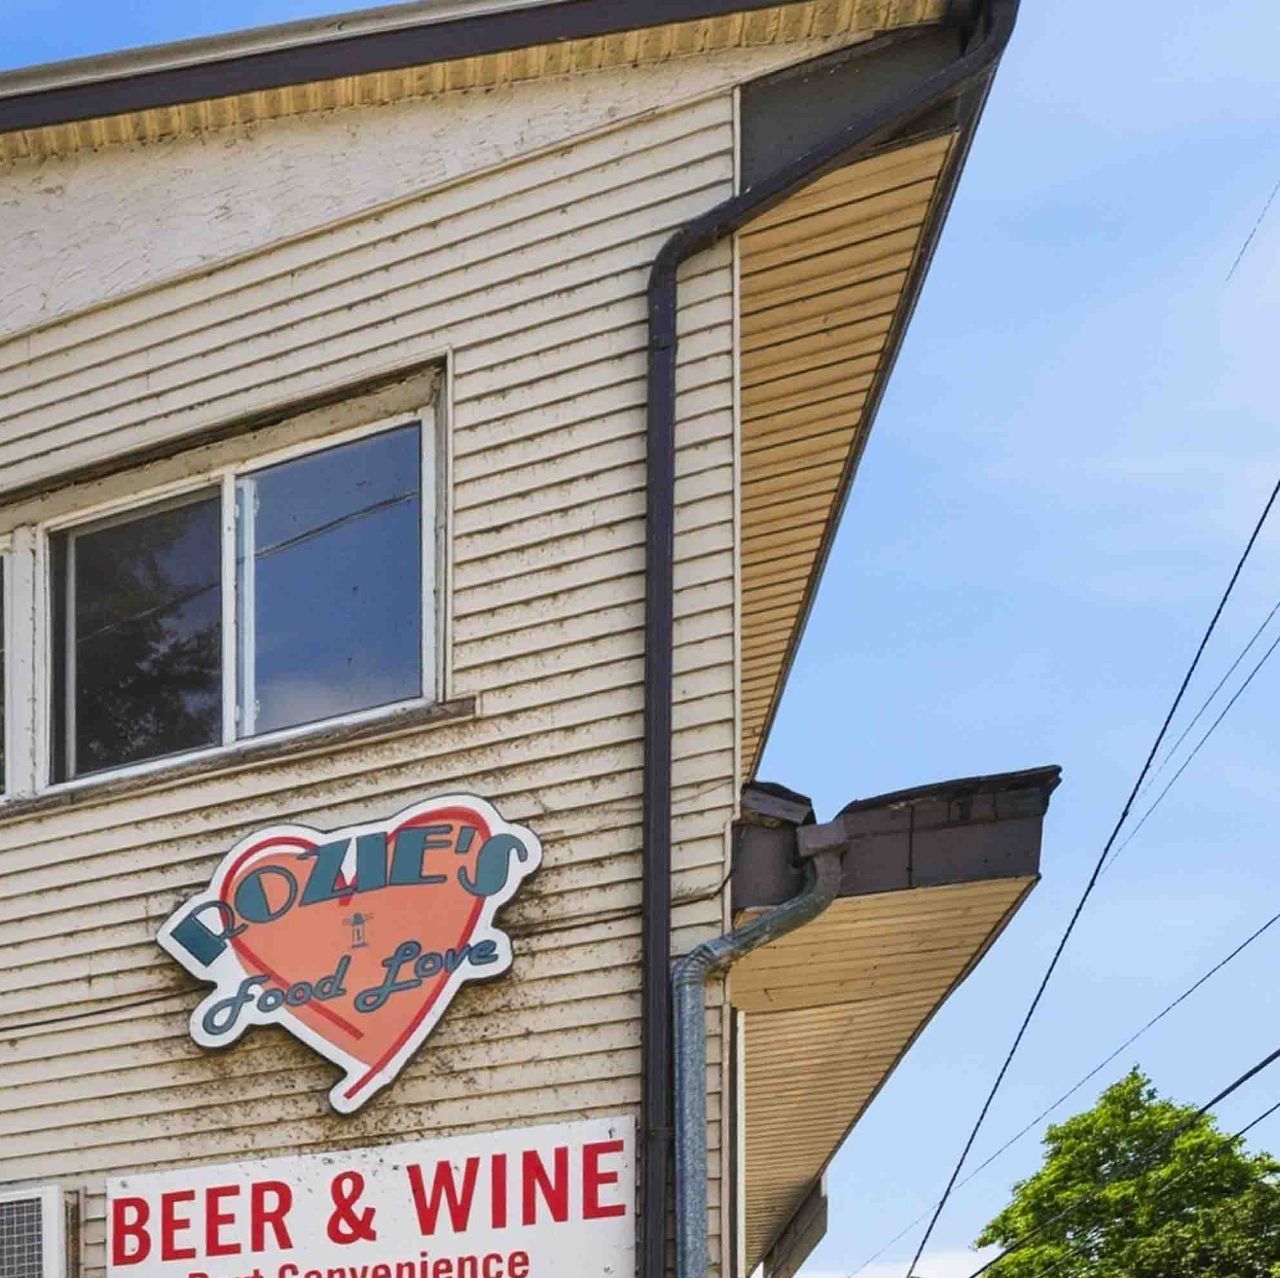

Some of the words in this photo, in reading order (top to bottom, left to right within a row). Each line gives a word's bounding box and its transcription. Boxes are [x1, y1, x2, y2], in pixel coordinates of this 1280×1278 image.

[170, 824, 528, 967] ROZIE'S
[202, 955, 351, 1035] Food
[353, 939, 499, 1013] Love
[112, 1180, 293, 1266] BEER
[327, 1170, 377, 1244] &
[406, 1139, 627, 1236] WINE
